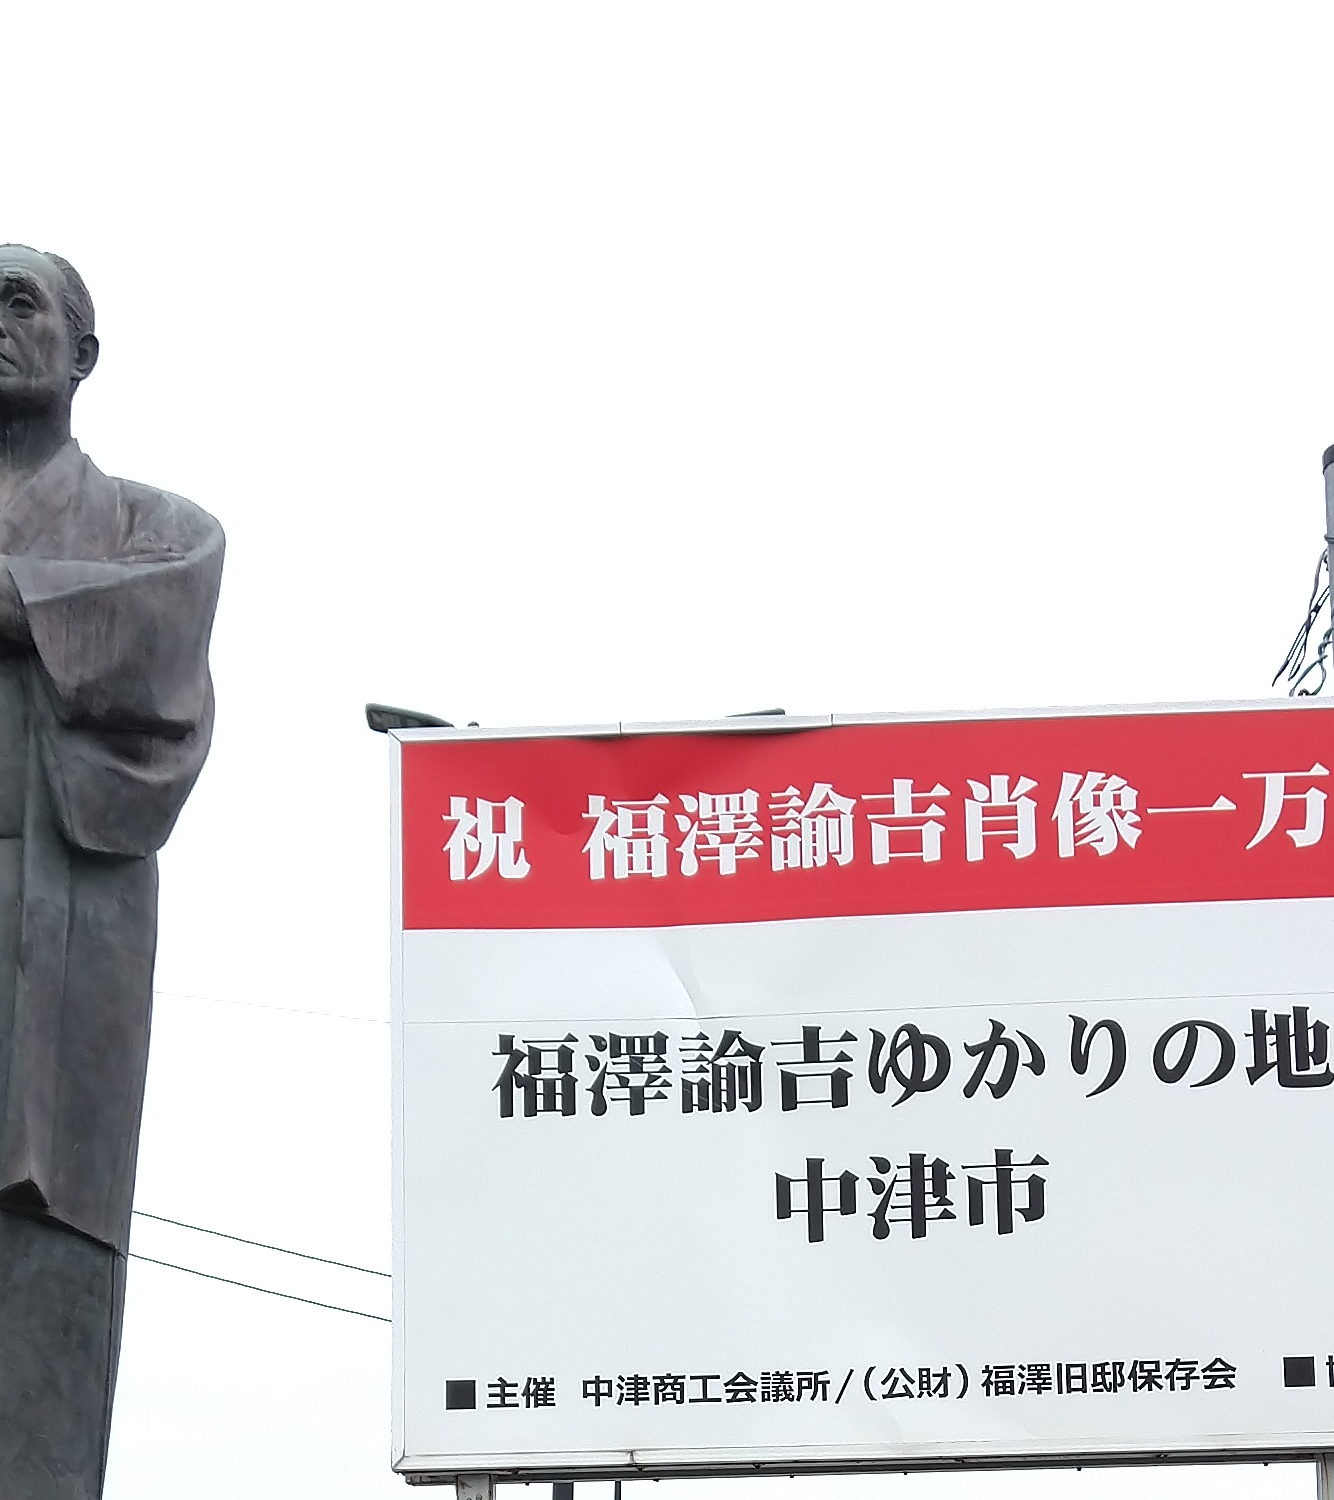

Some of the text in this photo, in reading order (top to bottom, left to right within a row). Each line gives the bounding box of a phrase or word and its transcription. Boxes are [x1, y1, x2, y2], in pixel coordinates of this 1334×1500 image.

[442, 794, 531, 880] 祝
[774, 1149, 1049, 1243] 中津市
[487, 1374, 557, 1409] 主催
